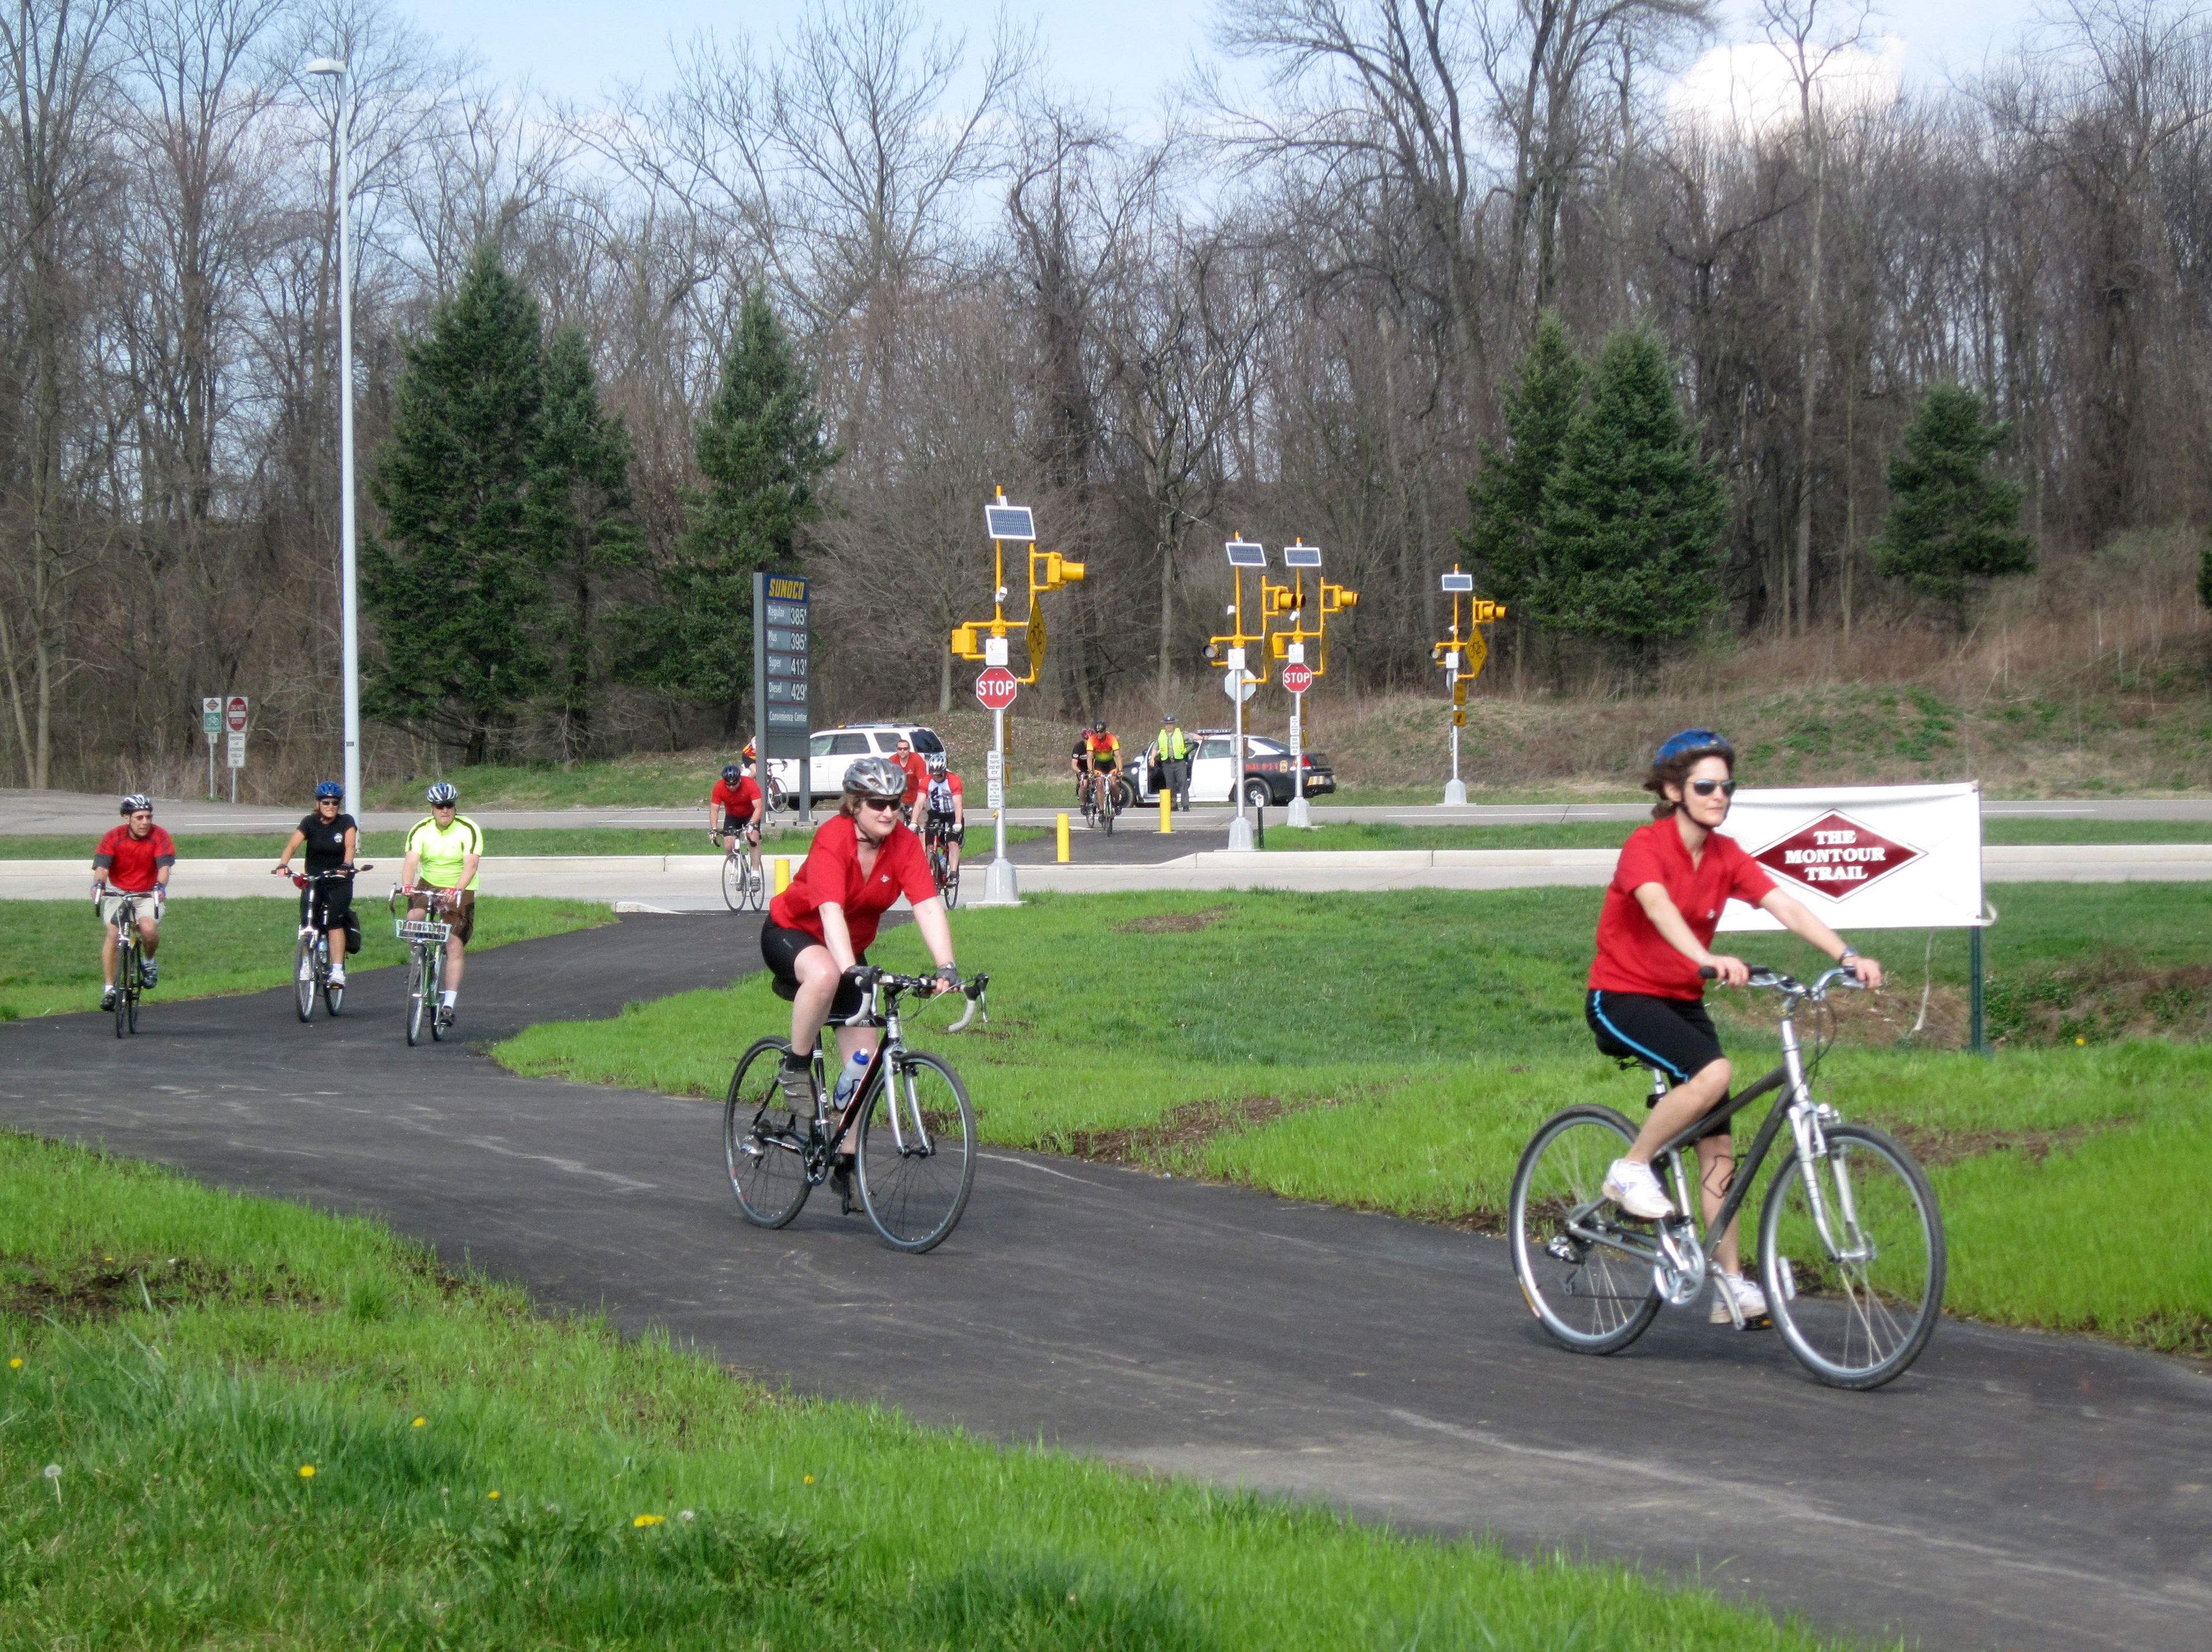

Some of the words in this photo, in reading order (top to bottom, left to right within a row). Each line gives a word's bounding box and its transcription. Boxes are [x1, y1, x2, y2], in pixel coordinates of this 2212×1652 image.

[769, 578, 805, 600] SUNOCO
[768, 605, 785, 619] Regular
[768, 631, 777, 642] Plus
[768, 656, 781, 669] Super
[1285, 672, 1310, 684] STOP
[768, 681, 782, 693] Diesel
[978, 680, 1014, 696] STOP
[769, 711, 793, 722] Convenience
[794, 712, 807, 722] Center
[1813, 830, 1857, 845] THE
[1785, 847, 1886, 864] MONTOUR
[1804, 866, 1869, 881] TRAIL
